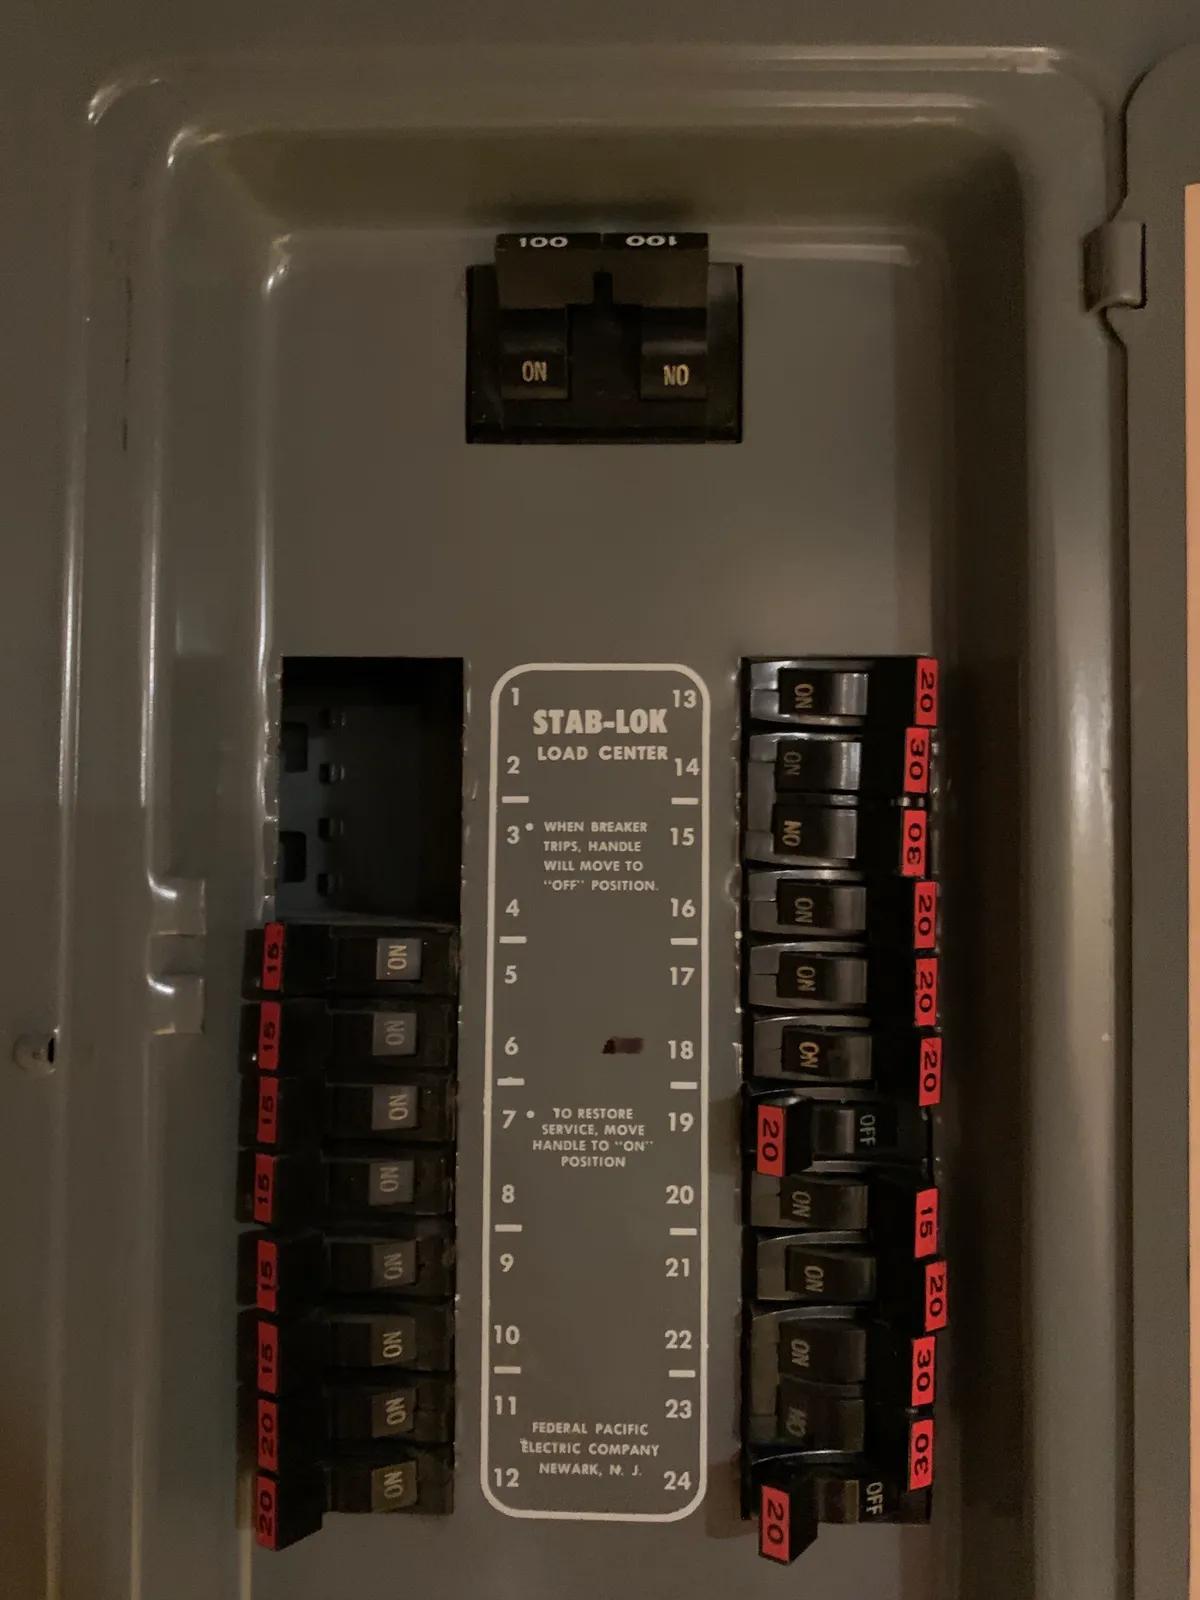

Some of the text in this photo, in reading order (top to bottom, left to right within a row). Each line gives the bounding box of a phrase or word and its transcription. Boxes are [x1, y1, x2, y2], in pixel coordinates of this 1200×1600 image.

[519, 236, 569, 248] 100
[625, 235, 677, 247] 100
[521, 360, 548, 383] ON
[663, 364, 690, 386] ON
[511, 687, 520, 706] 1
[672, 689, 697, 709] 13
[794, 683, 815, 710] ON
[920, 668, 934, 712] 20
[532, 708, 668, 735] STAB-LOK
[537, 745, 669, 761] LOAD CENTER
[783, 751, 803, 777] ON
[909, 738, 926, 781] 30
[506, 756, 520, 774] 2
[674, 758, 700, 776] 14
[506, 825, 520, 844] 3
[544, 821, 648, 832] WHEN BREAKER
[670, 827, 695, 846] 15
[781, 819, 803, 848] ON
[588, 841, 641, 852] HANDLE
[907, 823, 923, 865] 30
[544, 860, 644, 871] WILL MOVE TO
[591, 880, 659, 891] POSITION.
[506, 898, 520, 917] 4
[670, 897, 696, 918] 16
[794, 897, 814, 923] ON
[918, 894, 932, 936] 20
[387, 944, 408, 971] ON
[504, 965, 518, 984] 5
[670, 967, 695, 986] 17
[796, 966, 817, 992] ON
[919, 971, 934, 1013] 20
[384, 1020, 405, 1046] ON
[504, 1037, 519, 1055] 6
[668, 1040, 694, 1060] 18
[798, 1041, 820, 1068] ON
[923, 1050, 938, 1092] 20
[262, 1095, 275, 1124] 15
[388, 1094, 408, 1121] ON
[553, 1108, 633, 1120] TO RESTORE
[502, 1110, 517, 1129] 7
[541, 1124, 645, 1136] SERVICE, MOVE
[668, 1112, 694, 1132] 19
[859, 1113, 877, 1148] OFF
[532, 1140, 586, 1151] HANDLE
[590, 1140, 609, 1151] TO
[762, 1118, 779, 1162] 20
[560, 1156, 626, 1168] POSITION
[257, 1173, 270, 1205] 15
[379, 1167, 399, 1193] ON
[501, 1184, 515, 1204] 8
[665, 1185, 695, 1205] 20
[791, 1190, 812, 1218] ON
[919, 1207, 933, 1238] 15
[384, 1252, 403, 1280] ON
[500, 1253, 514, 1273] 9
[665, 1257, 690, 1278] 21
[260, 1261, 275, 1290] 15
[803, 1265, 825, 1293] ON
[930, 1275, 944, 1316] 20
[382, 1331, 403, 1359] ON
[493, 1325, 520, 1345] 10
[664, 1330, 692, 1350] 22
[261, 1344, 273, 1374] 15
[790, 1338, 811, 1368] ON
[916, 1349, 931, 1392] 30
[385, 1397, 406, 1426] ON
[494, 1395, 517, 1416] 11
[665, 1398, 692, 1419] 23
[261, 1413, 274, 1458] 20
[532, 1421, 649, 1436] FEDERAL PACIFIC
[521, 1440, 660, 1457] ELECTRIC COMPANY
[914, 1434, 929, 1477] 30
[494, 1468, 520, 1488] 12
[539, 1463, 642, 1477] NEWARK, N. J.
[663, 1471, 692, 1491] 24
[383, 1471, 403, 1499] ON
[865, 1481, 884, 1516] OFF
[259, 1491, 272, 1536] 20
[766, 1499, 784, 1545] 20
